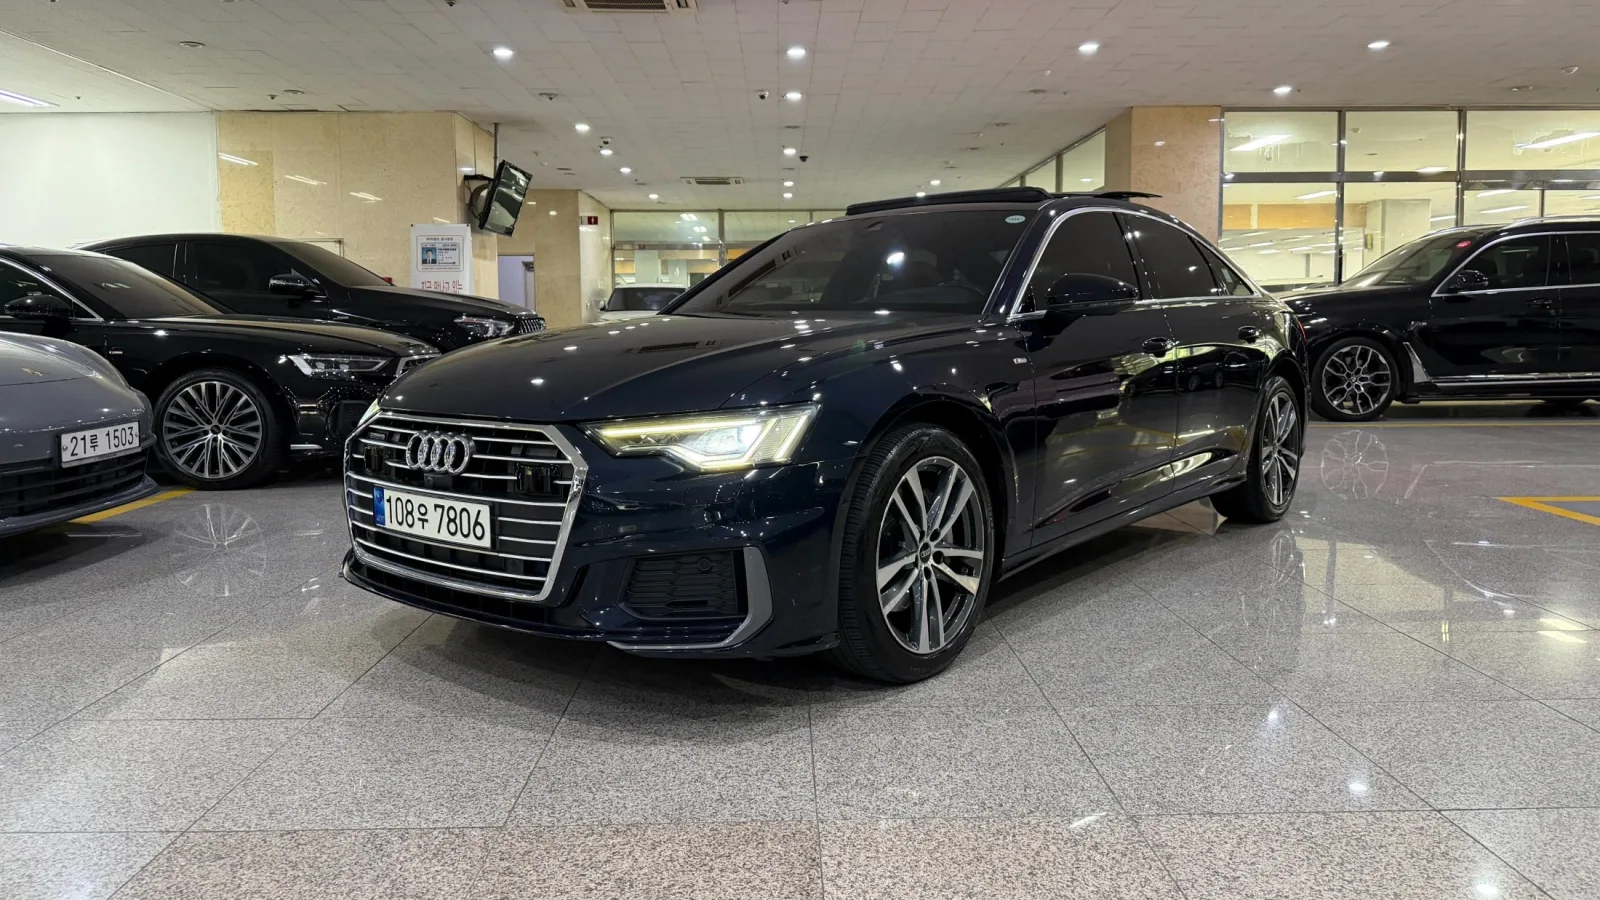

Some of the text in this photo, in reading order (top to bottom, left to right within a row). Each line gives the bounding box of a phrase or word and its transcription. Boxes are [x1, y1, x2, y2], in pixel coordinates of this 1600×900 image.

[70, 426, 134, 457] 21루 1503
[386, 495, 485, 541] 108우 7806
